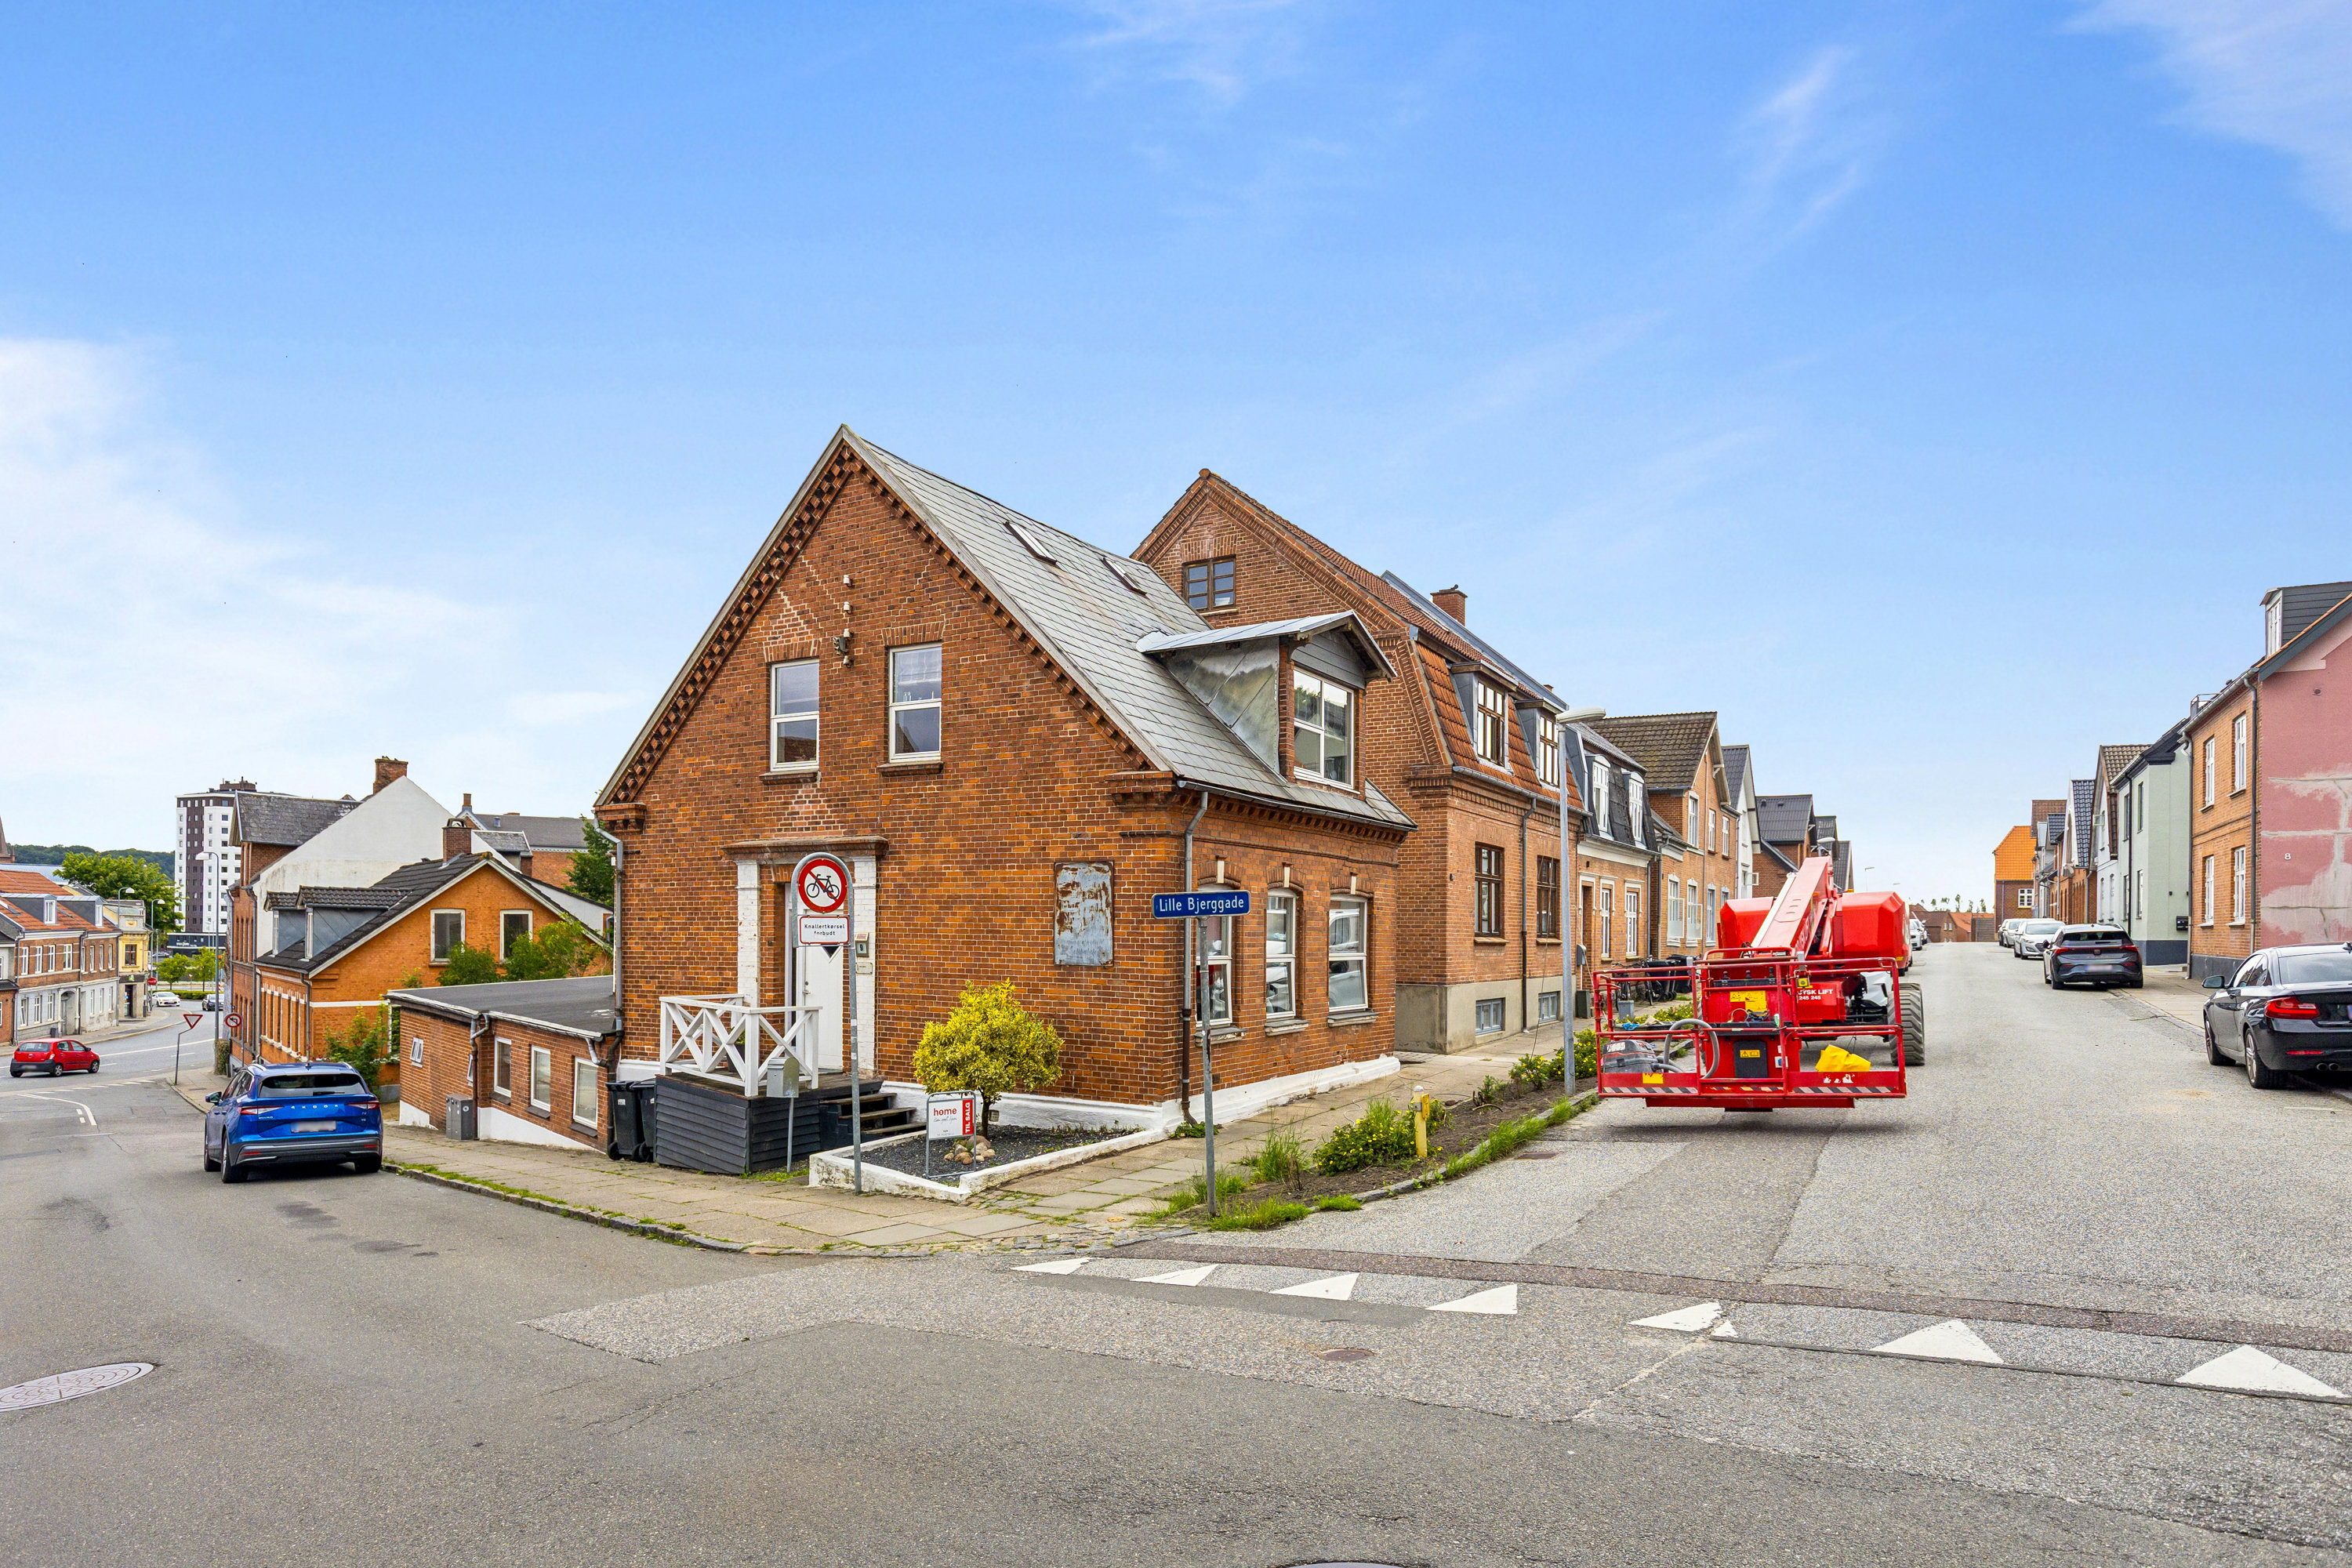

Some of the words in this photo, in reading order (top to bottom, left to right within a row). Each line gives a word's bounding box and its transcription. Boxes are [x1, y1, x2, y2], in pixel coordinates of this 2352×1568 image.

[1159, 898, 1182, 912] Lille
[1188, 895, 1244, 914] Bjerggade
[933, 1107, 957, 1116] home
